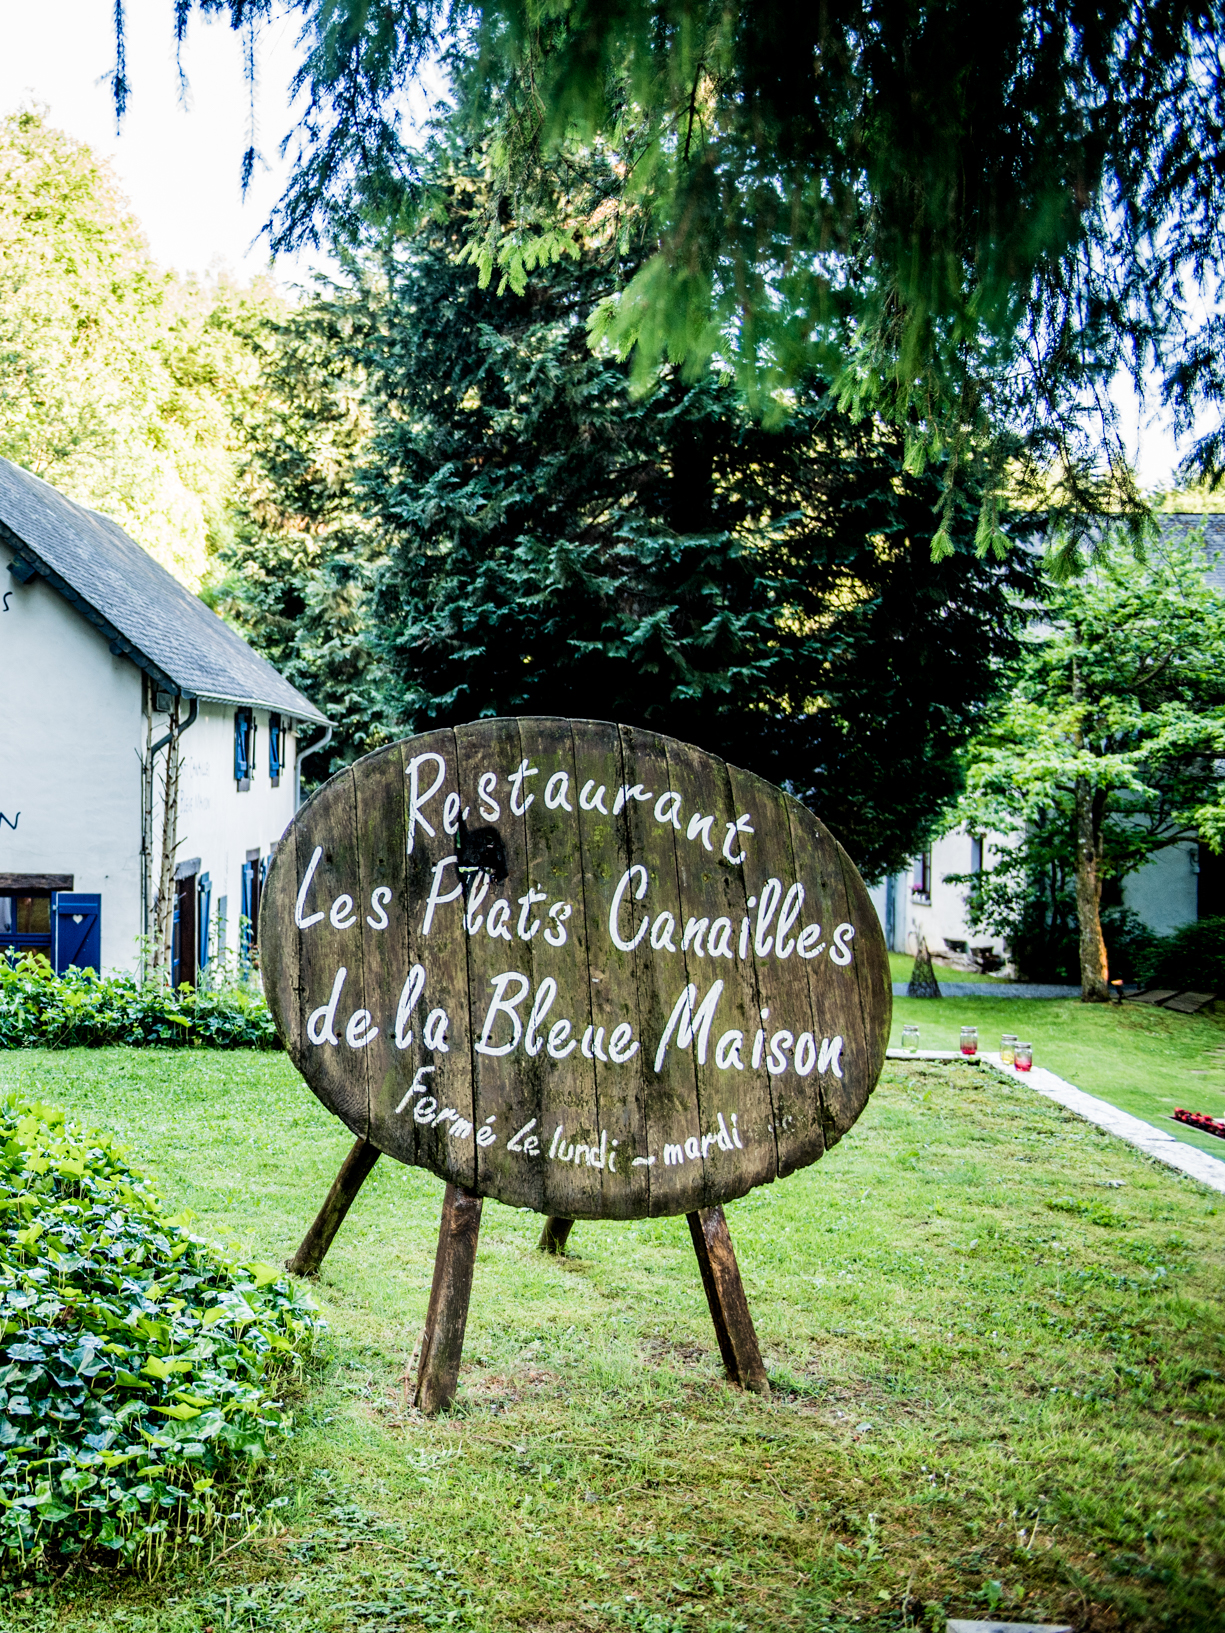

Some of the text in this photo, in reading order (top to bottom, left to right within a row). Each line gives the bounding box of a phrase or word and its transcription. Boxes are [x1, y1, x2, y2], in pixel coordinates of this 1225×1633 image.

[404, 752, 755, 866] Restaurant
[294, 845, 856, 967] Les Plats Canailles
[306, 963, 845, 1080] de la Bleue Maison
[394, 1065, 498, 1148] Fermé
[549, 1124, 619, 1174] lundi
[662, 1111, 745, 1167] mardi
